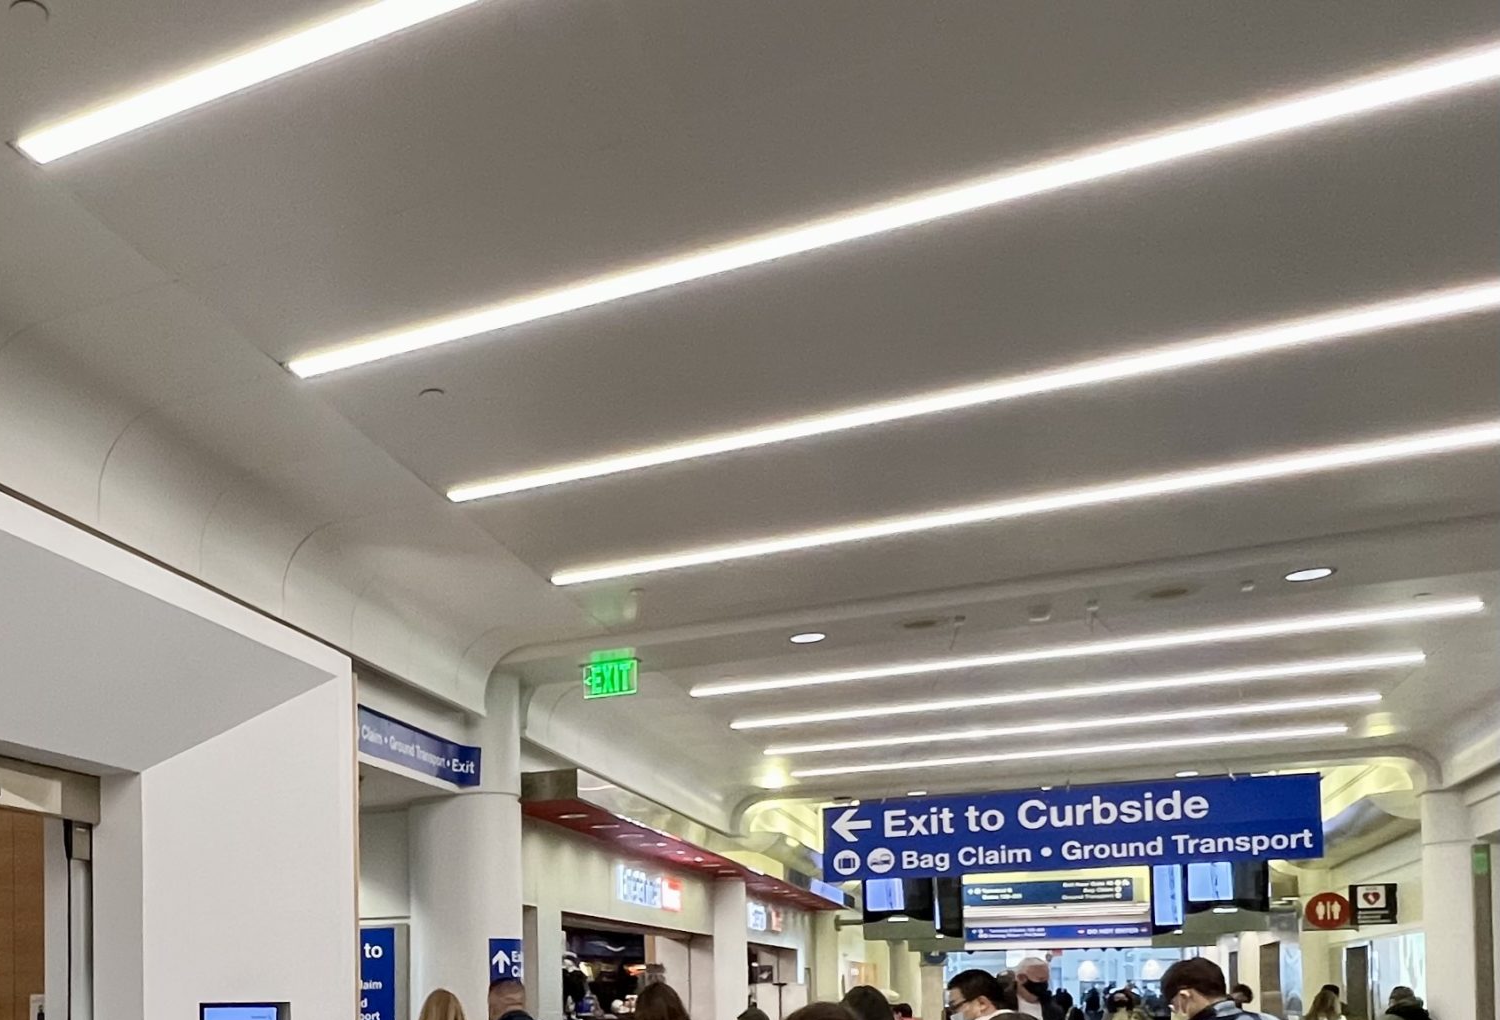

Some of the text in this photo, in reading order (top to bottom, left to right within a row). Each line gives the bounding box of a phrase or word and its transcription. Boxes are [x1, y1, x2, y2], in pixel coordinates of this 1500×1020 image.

[591, 663, 631, 695] EXIT
[361, 725, 475, 774] Claim Ground Transport Exit
[884, 790, 1210, 838] Exit to Curbside
[902, 829, 1313, 872] Bag Claim Ground Transport
[364, 943, 383, 959] to
[360, 980, 382, 990] laim
